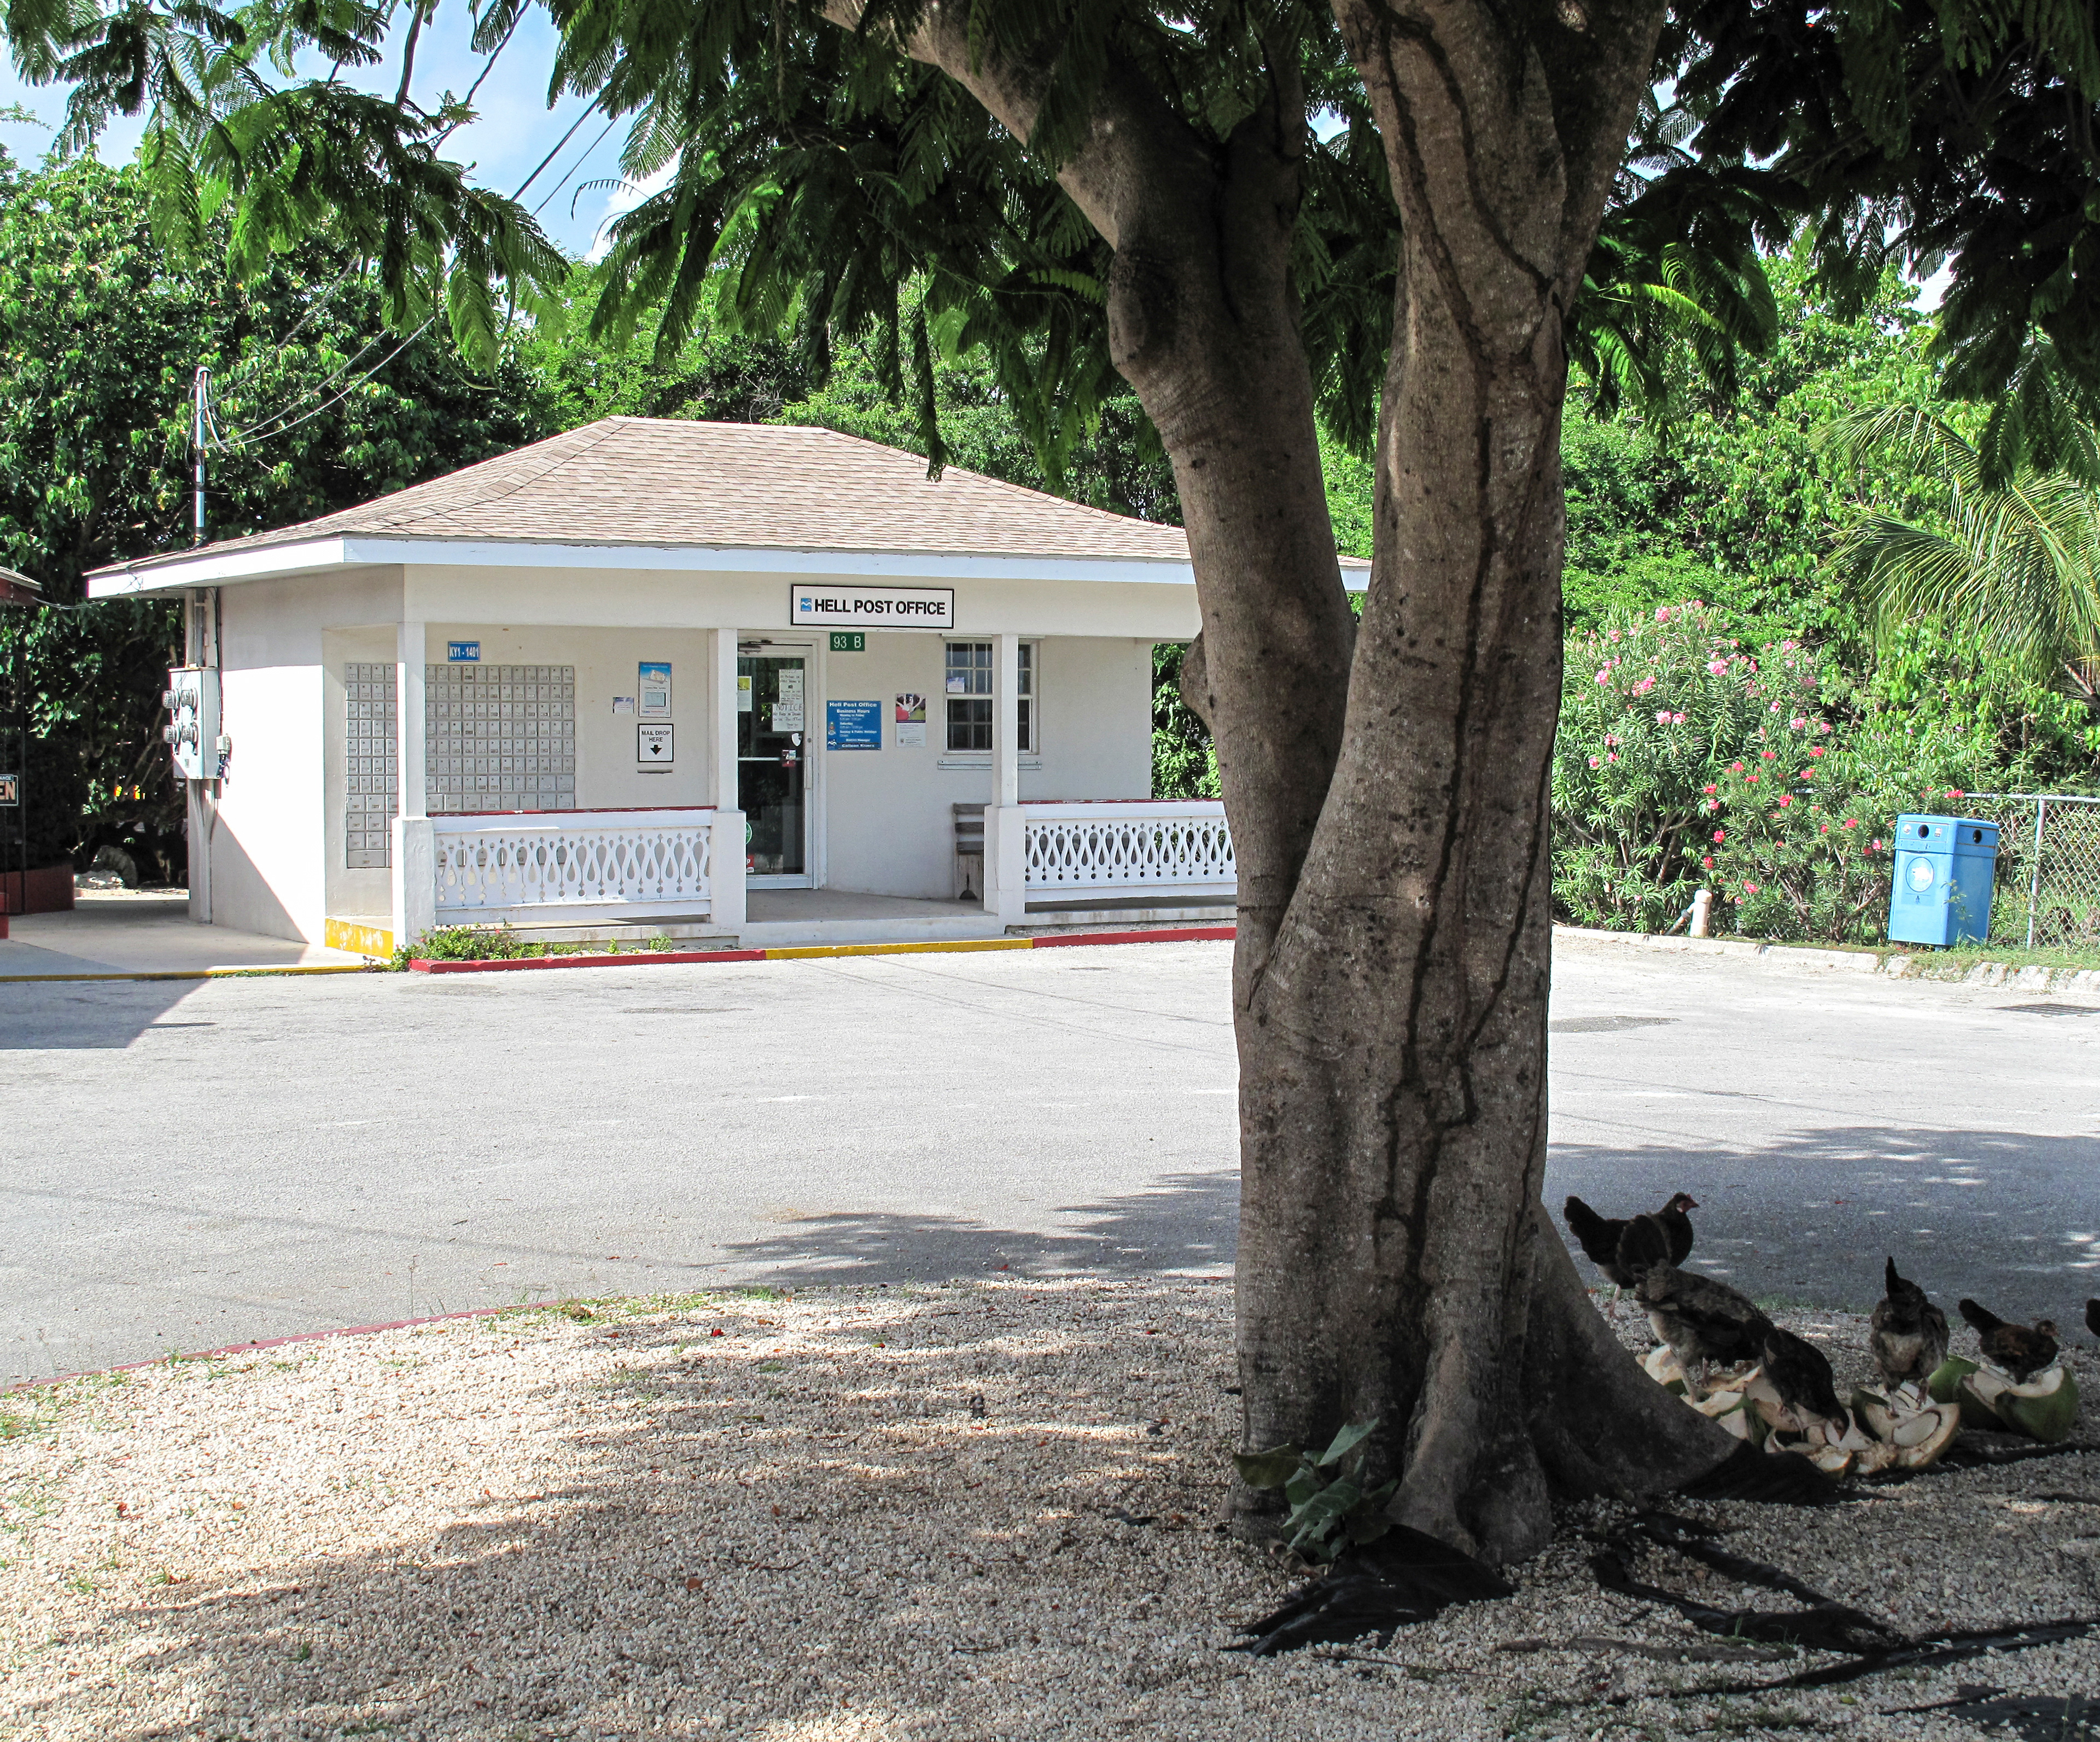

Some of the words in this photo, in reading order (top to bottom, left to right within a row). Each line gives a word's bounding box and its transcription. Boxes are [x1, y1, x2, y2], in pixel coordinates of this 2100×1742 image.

[815, 599, 851, 613] HELL
[854, 600, 893, 614] POST
[896, 601, 946, 615] OFFICE
[833, 636, 847, 648] 93
[854, 636, 861, 648] B
[450, 647, 460, 657] KY1
[466, 647, 479, 657] 1401
